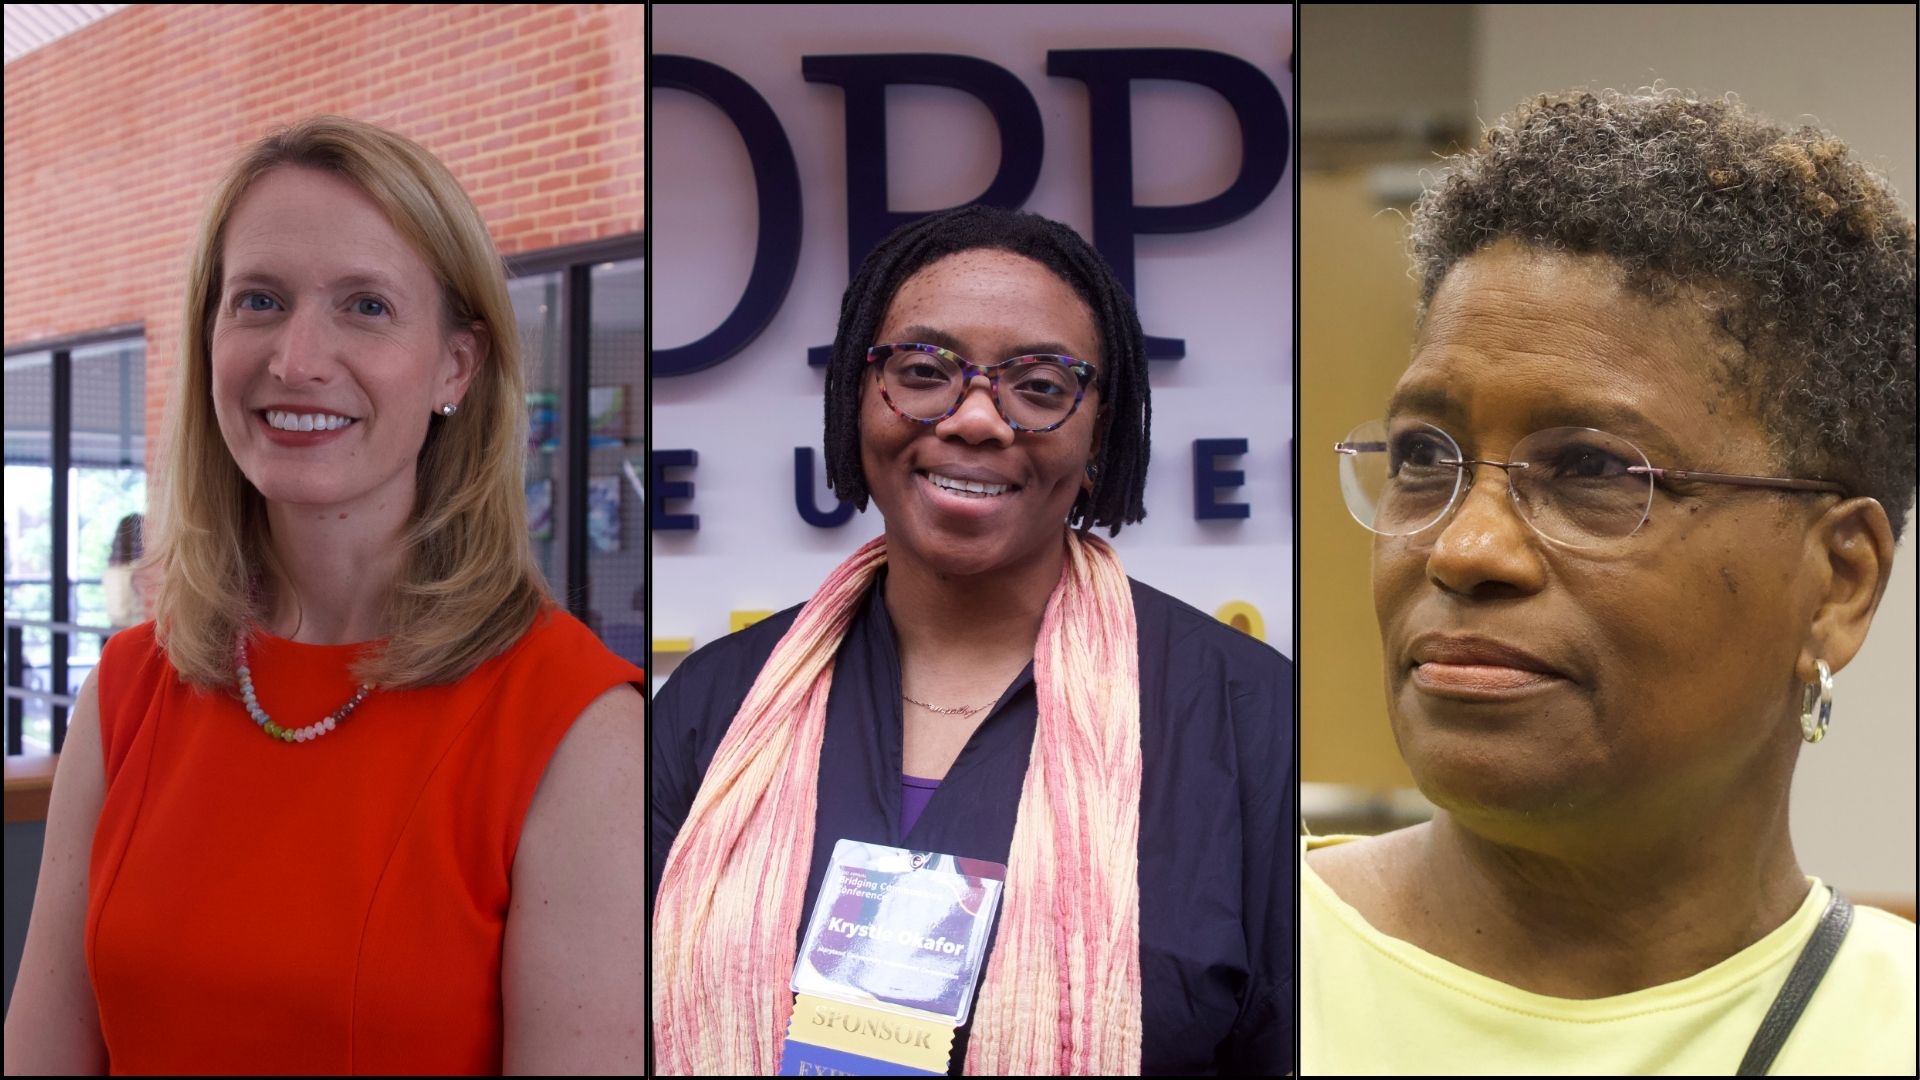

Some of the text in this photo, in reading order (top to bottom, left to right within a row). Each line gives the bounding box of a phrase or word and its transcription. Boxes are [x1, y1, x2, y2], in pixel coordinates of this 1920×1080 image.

[839, 875, 878, 891] Bridging
[897, 929, 964, 956] Okafor
[811, 1004, 932, 1049] SPONSOR
